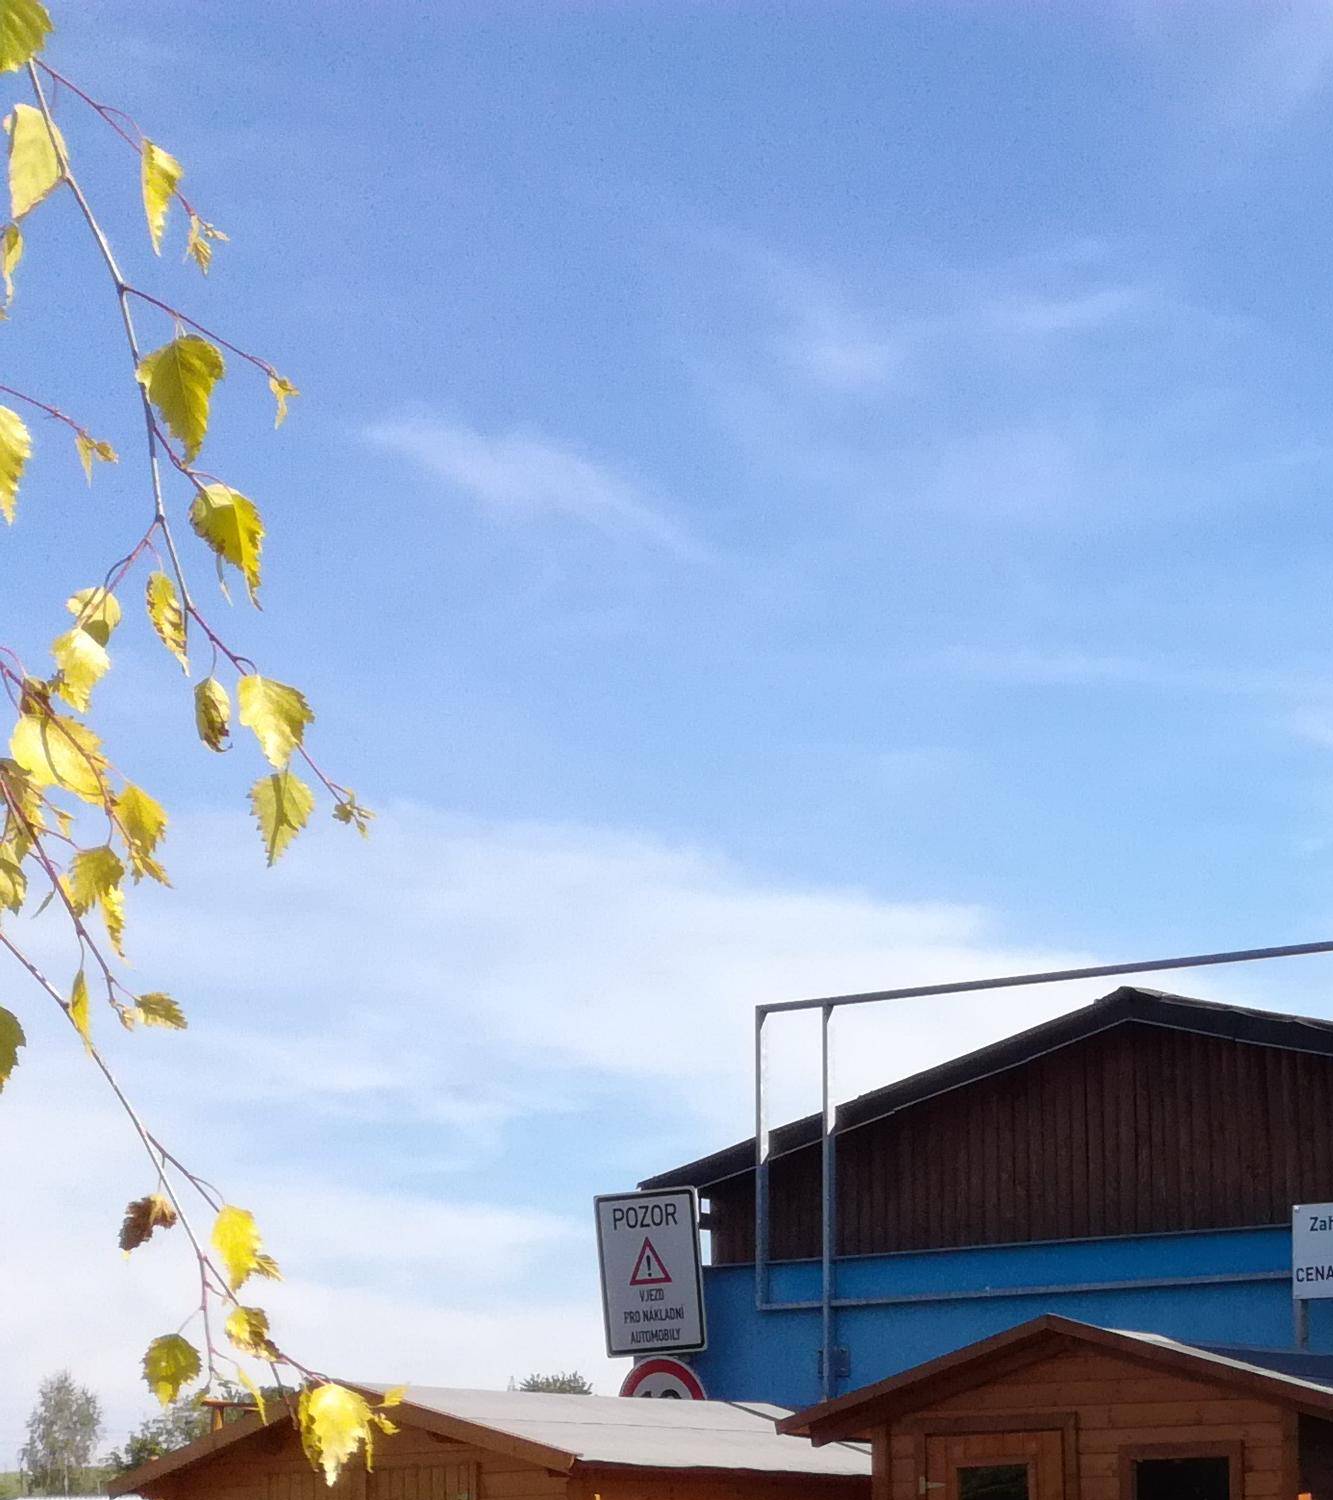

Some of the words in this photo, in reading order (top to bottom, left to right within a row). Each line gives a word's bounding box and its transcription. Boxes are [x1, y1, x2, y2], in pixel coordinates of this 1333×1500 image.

[613, 1203, 678, 1231] POZOR
[639, 1288, 665, 1302] VJEZD
[624, 1311, 641, 1324] PRO
[630, 1328, 681, 1344] AUTOMOBILY
